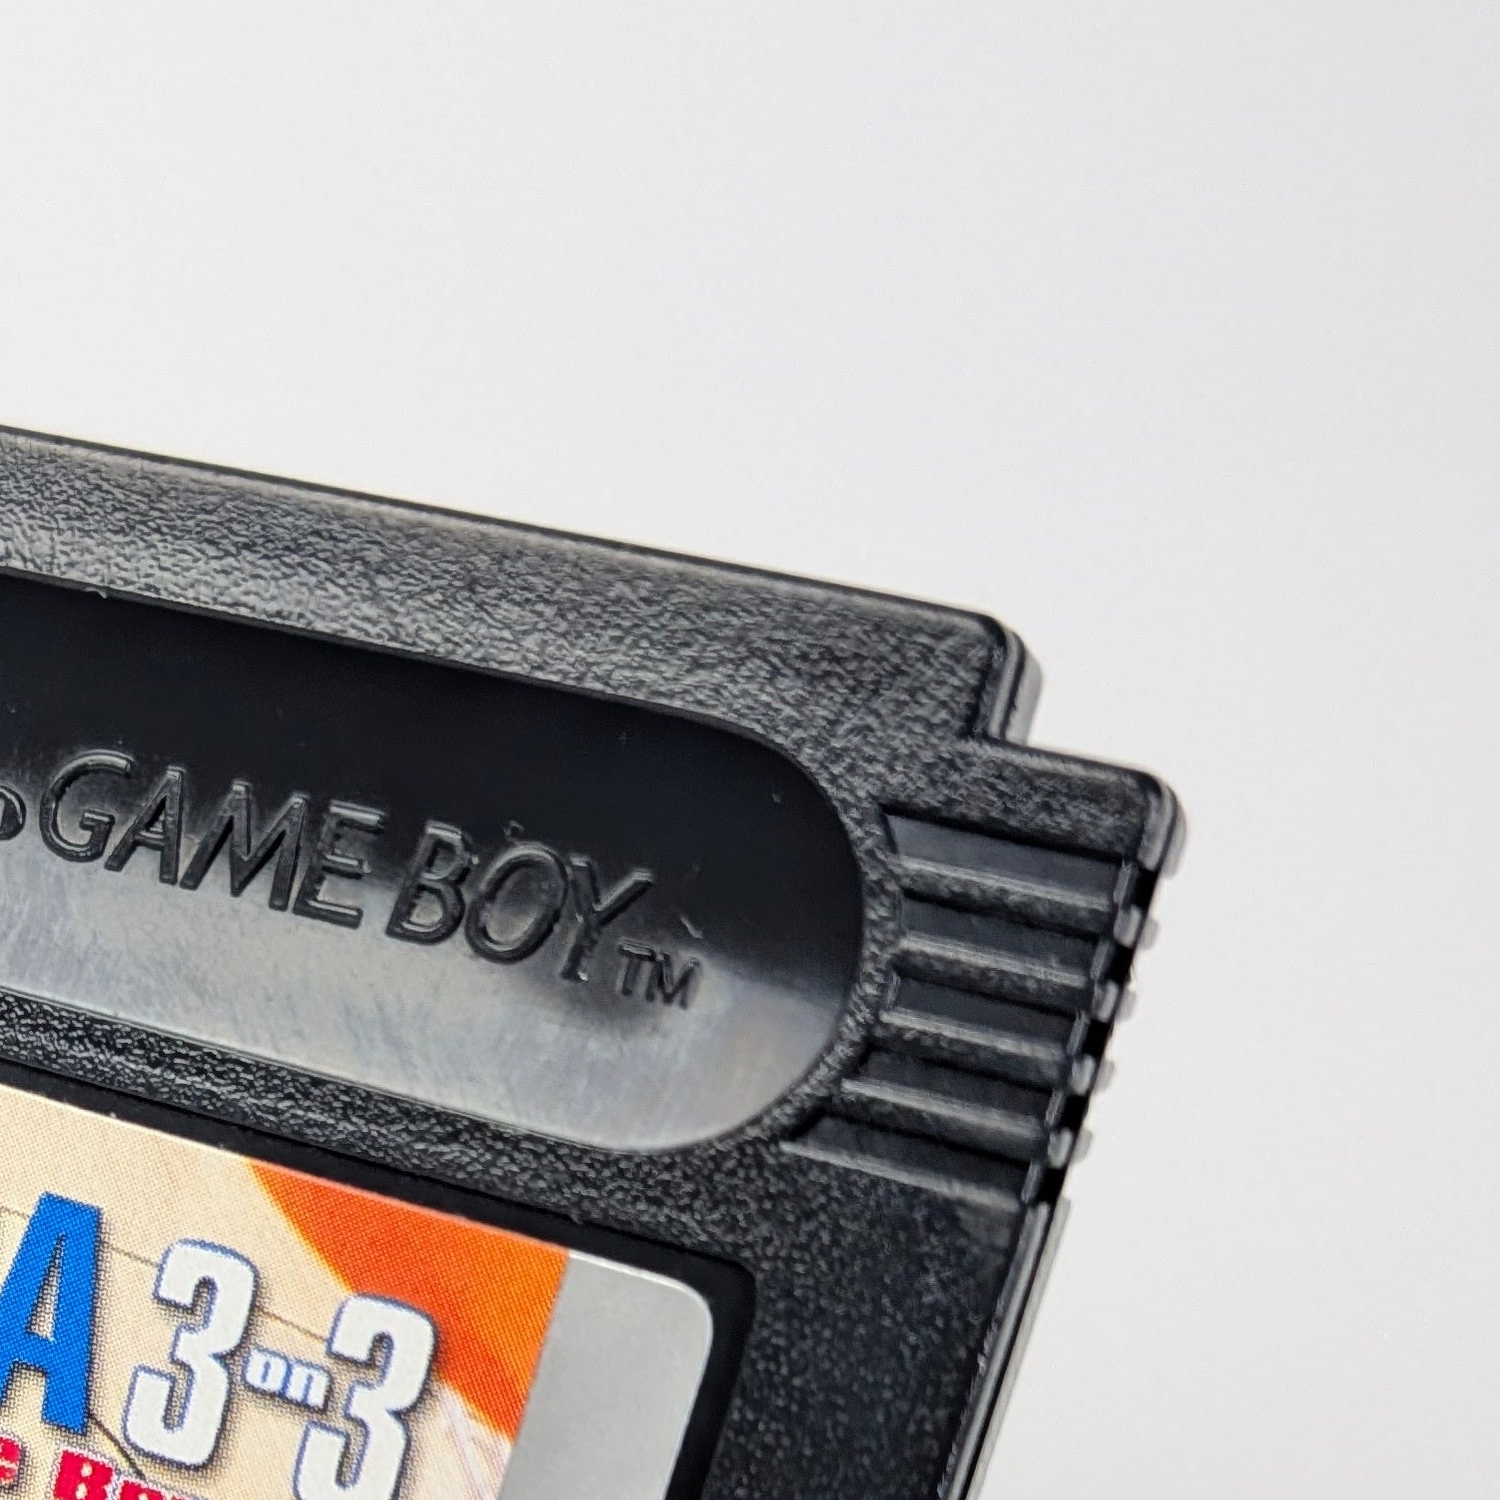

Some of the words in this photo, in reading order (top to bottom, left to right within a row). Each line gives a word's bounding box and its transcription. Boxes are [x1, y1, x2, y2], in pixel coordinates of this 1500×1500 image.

[40, 750, 386, 928] GAME
[386, 821, 653, 983] BOY
[122, 1237, 259, 1470] 3
[244, 1344, 331, 1412] on
